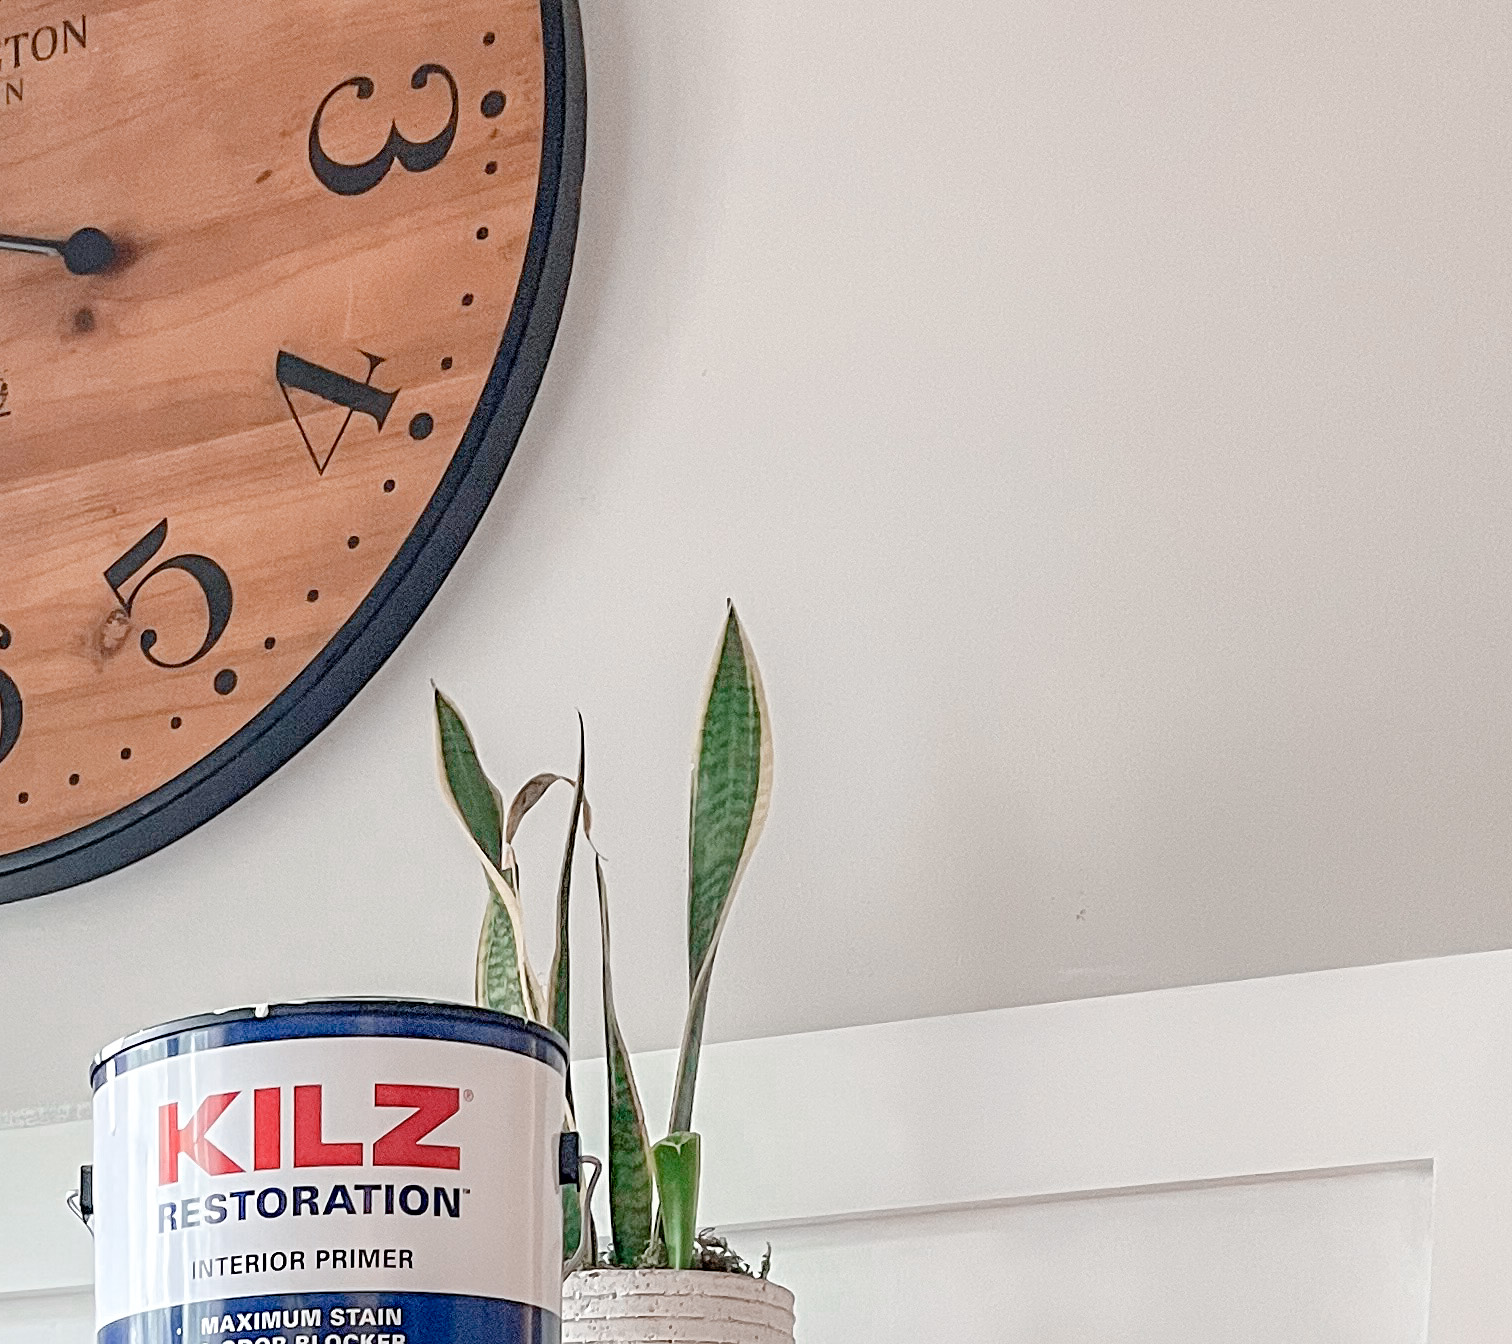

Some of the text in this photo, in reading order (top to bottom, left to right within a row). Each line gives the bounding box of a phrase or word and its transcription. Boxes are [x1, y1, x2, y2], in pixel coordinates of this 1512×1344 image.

[308, 63, 459, 196] 3
[275, 350, 402, 476] 4
[103, 519, 234, 670] 5
[158, 1083, 461, 1186] KILZ
[158, 1184, 461, 1234] RESTORATION
[191, 1249, 413, 1281] INTERIOR PRIMER
[201, 1308, 402, 1335] MAXIMUM STAIN
